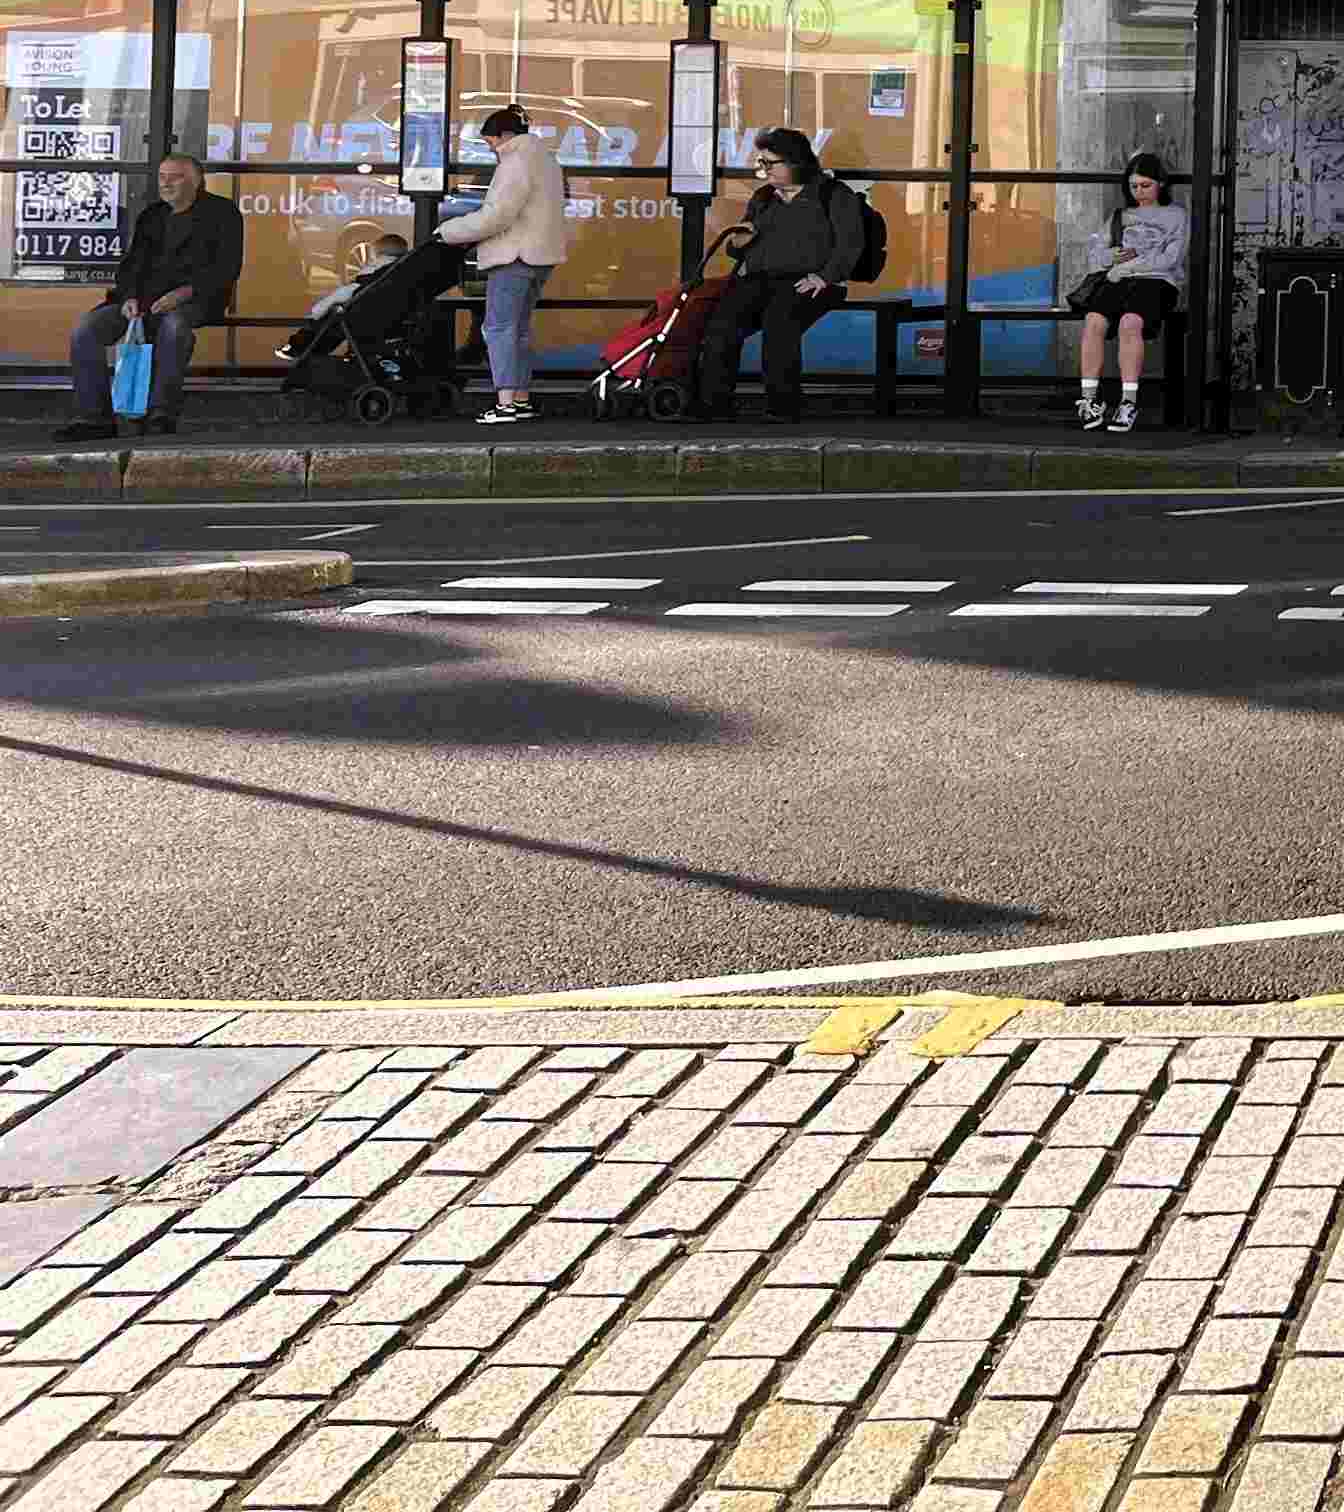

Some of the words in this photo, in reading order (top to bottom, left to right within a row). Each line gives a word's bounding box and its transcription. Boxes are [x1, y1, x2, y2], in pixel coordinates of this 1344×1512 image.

[20, 95, 52, 118] To
[55, 95, 92, 118] Let
[238, 190, 312, 215] co.uk
[16, 234, 72, 256] 0117
[79, 235, 122, 256] 984
